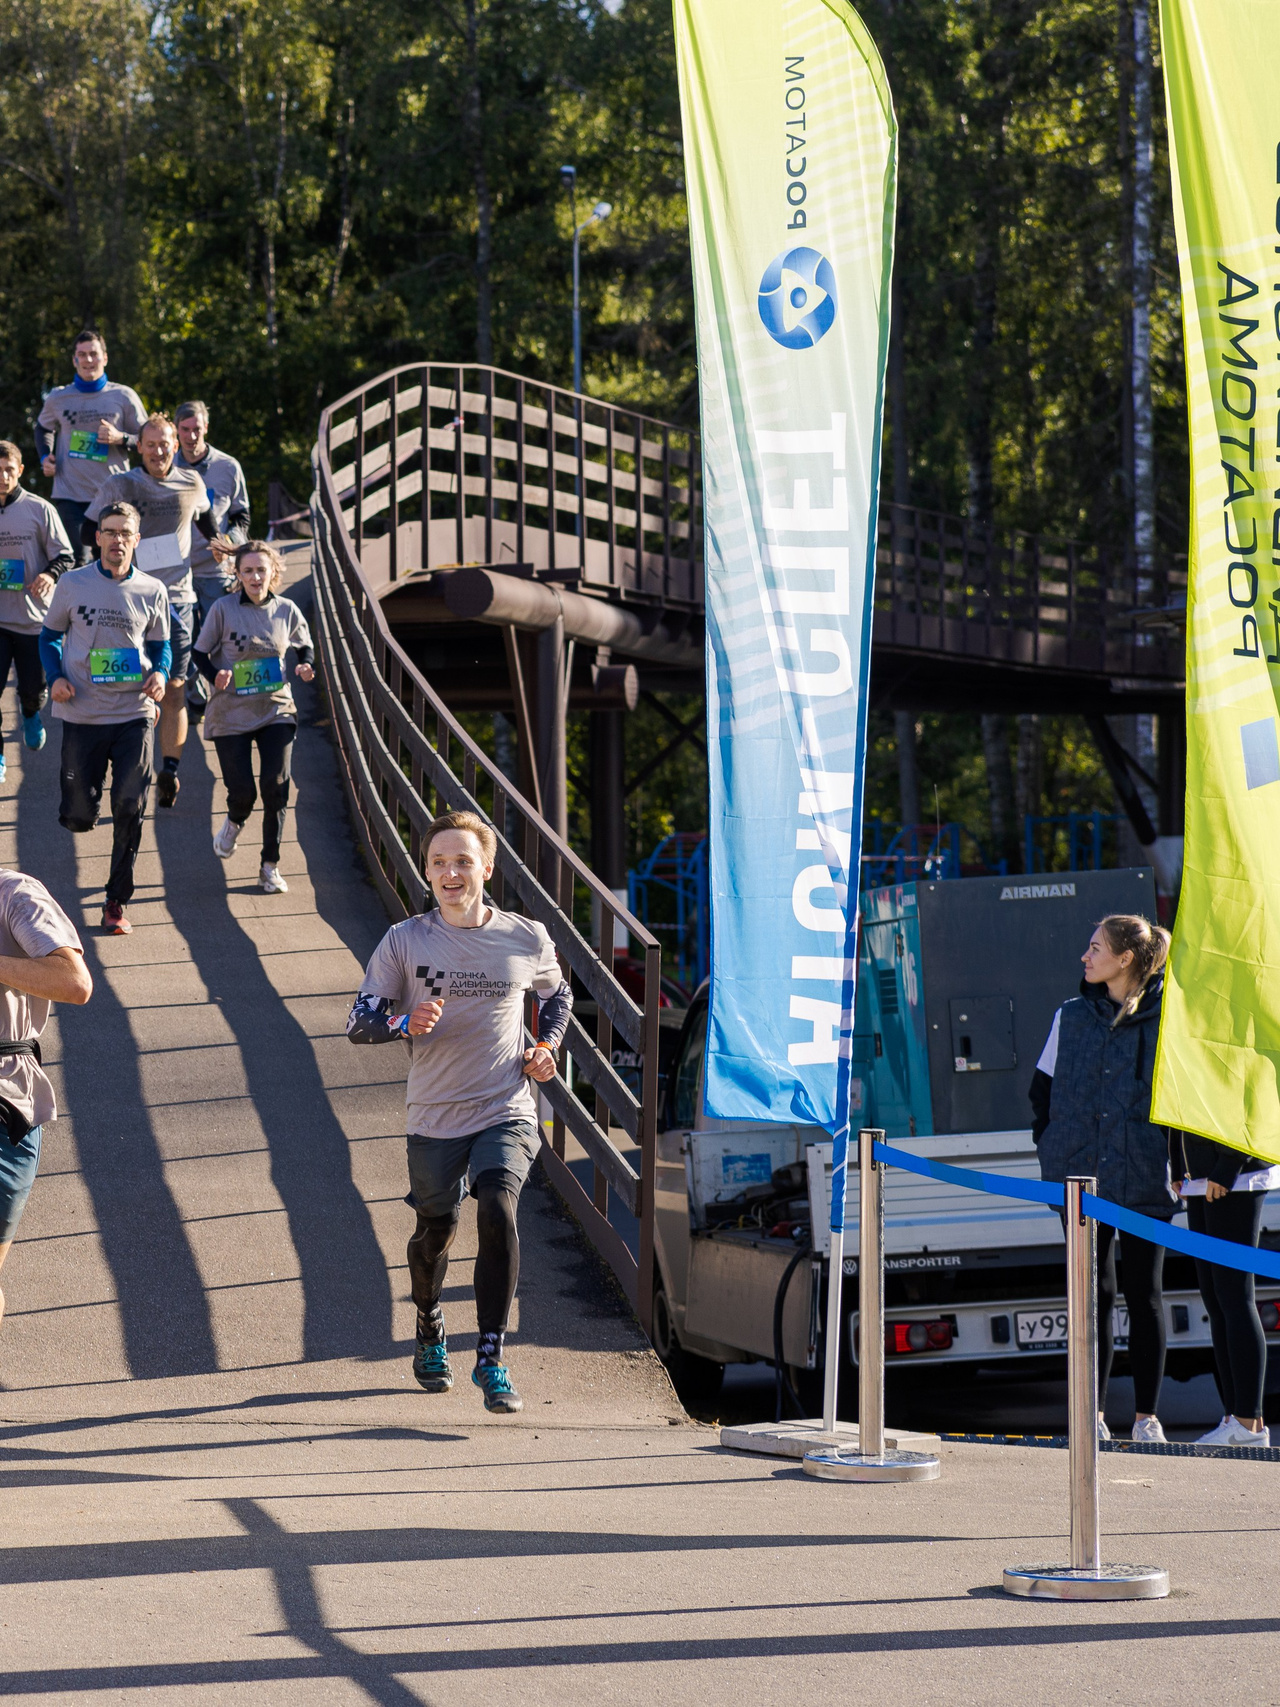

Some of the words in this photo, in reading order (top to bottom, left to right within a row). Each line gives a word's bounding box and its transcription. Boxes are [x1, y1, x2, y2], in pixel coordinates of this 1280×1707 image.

[101, 659, 130, 674] 266
[244, 668, 271, 685] 264
[1000, 883, 1076, 900] AIRMAN
[449, 971, 487, 979] ГОНКА
[449, 980, 522, 989] ДИВИЗИОНОВ
[449, 989, 507, 997] РОСАТОМА
[882, 1256, 962, 1270] ANSPORTER
